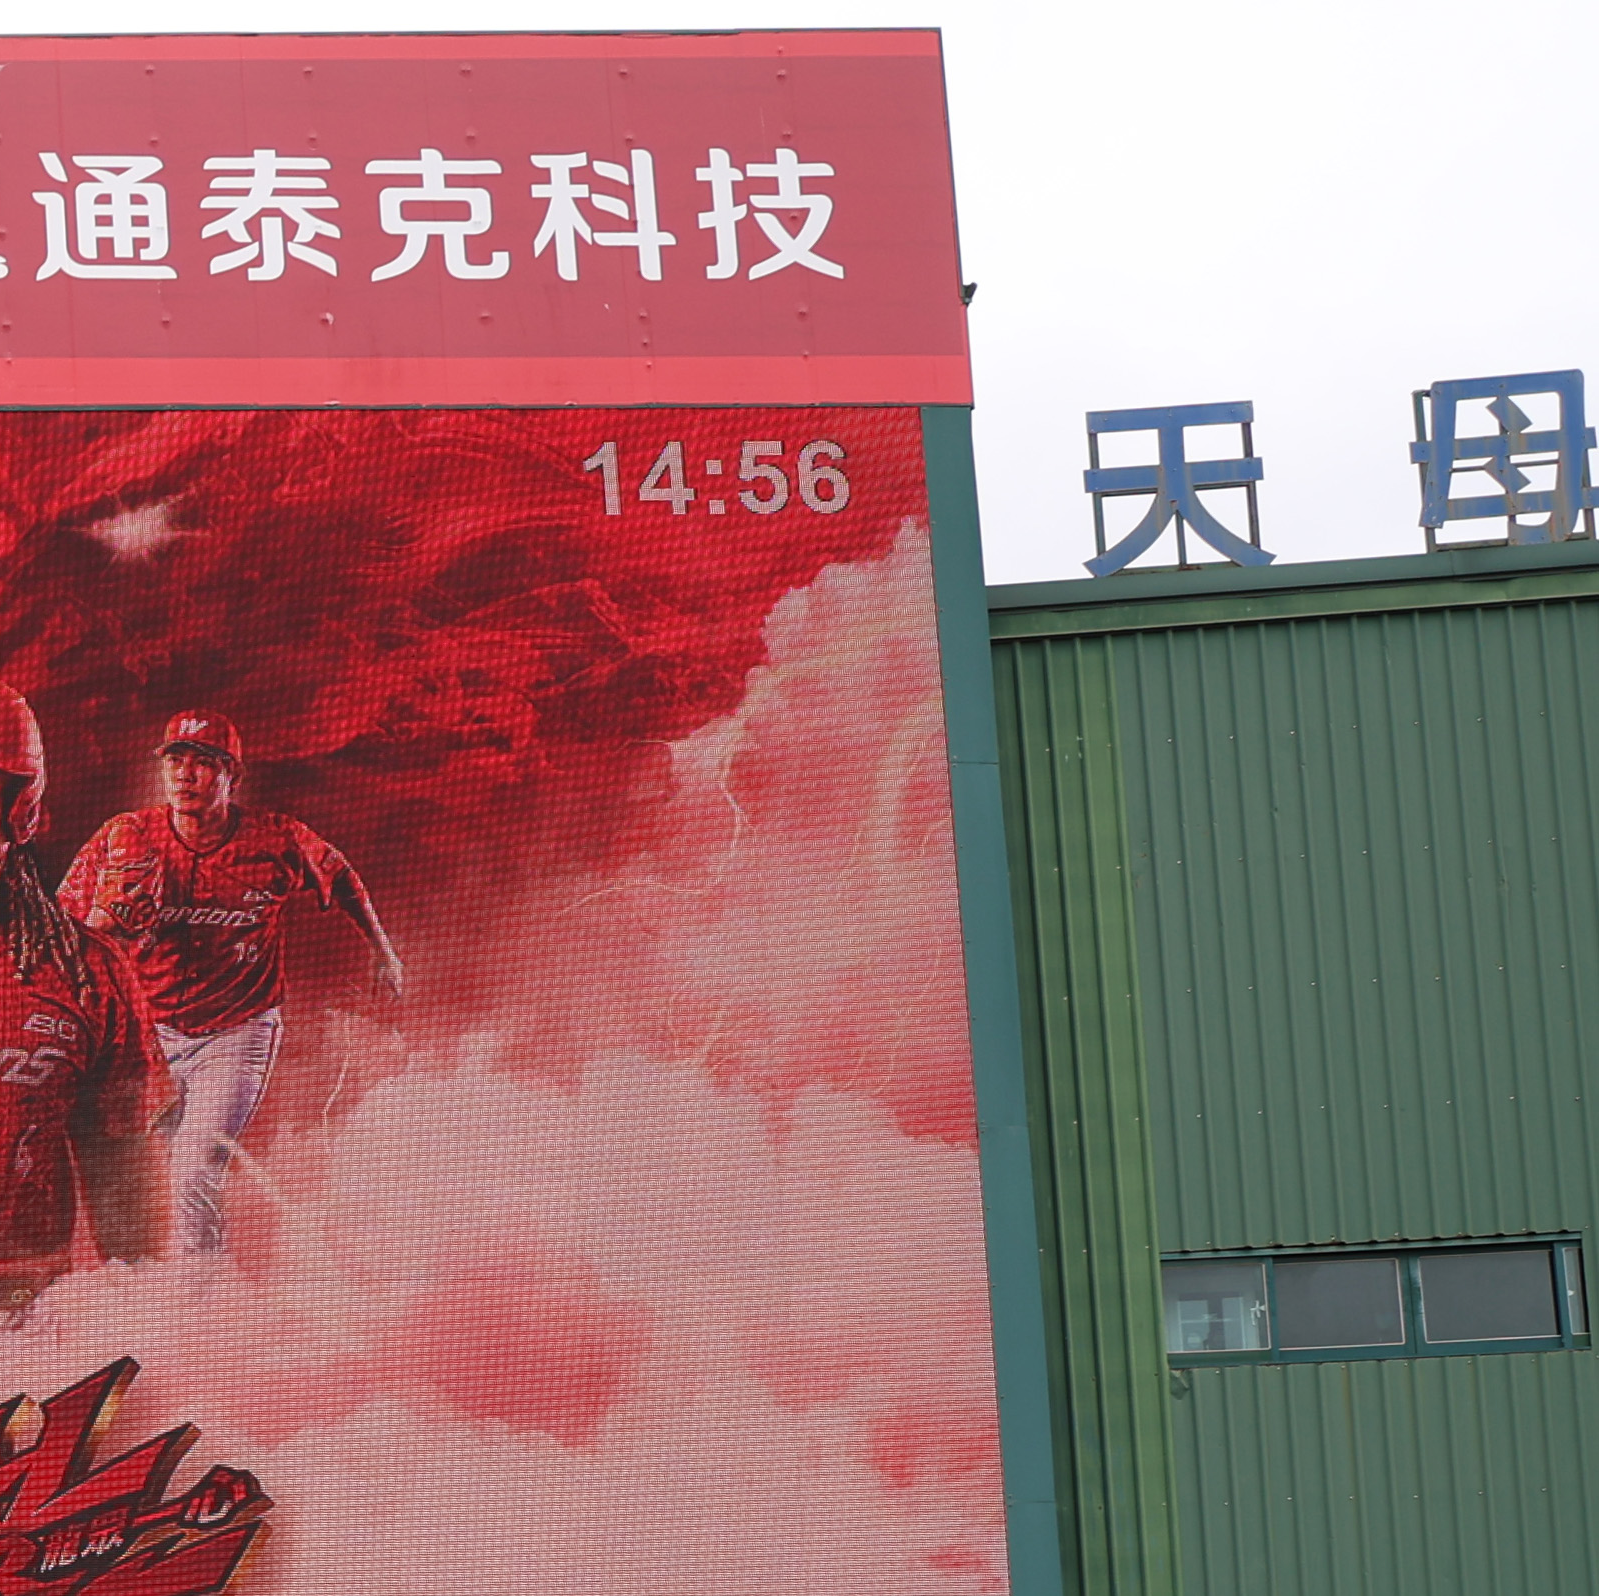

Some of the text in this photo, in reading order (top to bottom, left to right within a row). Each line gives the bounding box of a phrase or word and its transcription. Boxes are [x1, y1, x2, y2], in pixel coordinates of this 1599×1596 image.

[33, 149, 844, 282] 通泰克科技
[583, 440, 851, 516] 14:56
[1083, 369, 1599, 577] 天母
